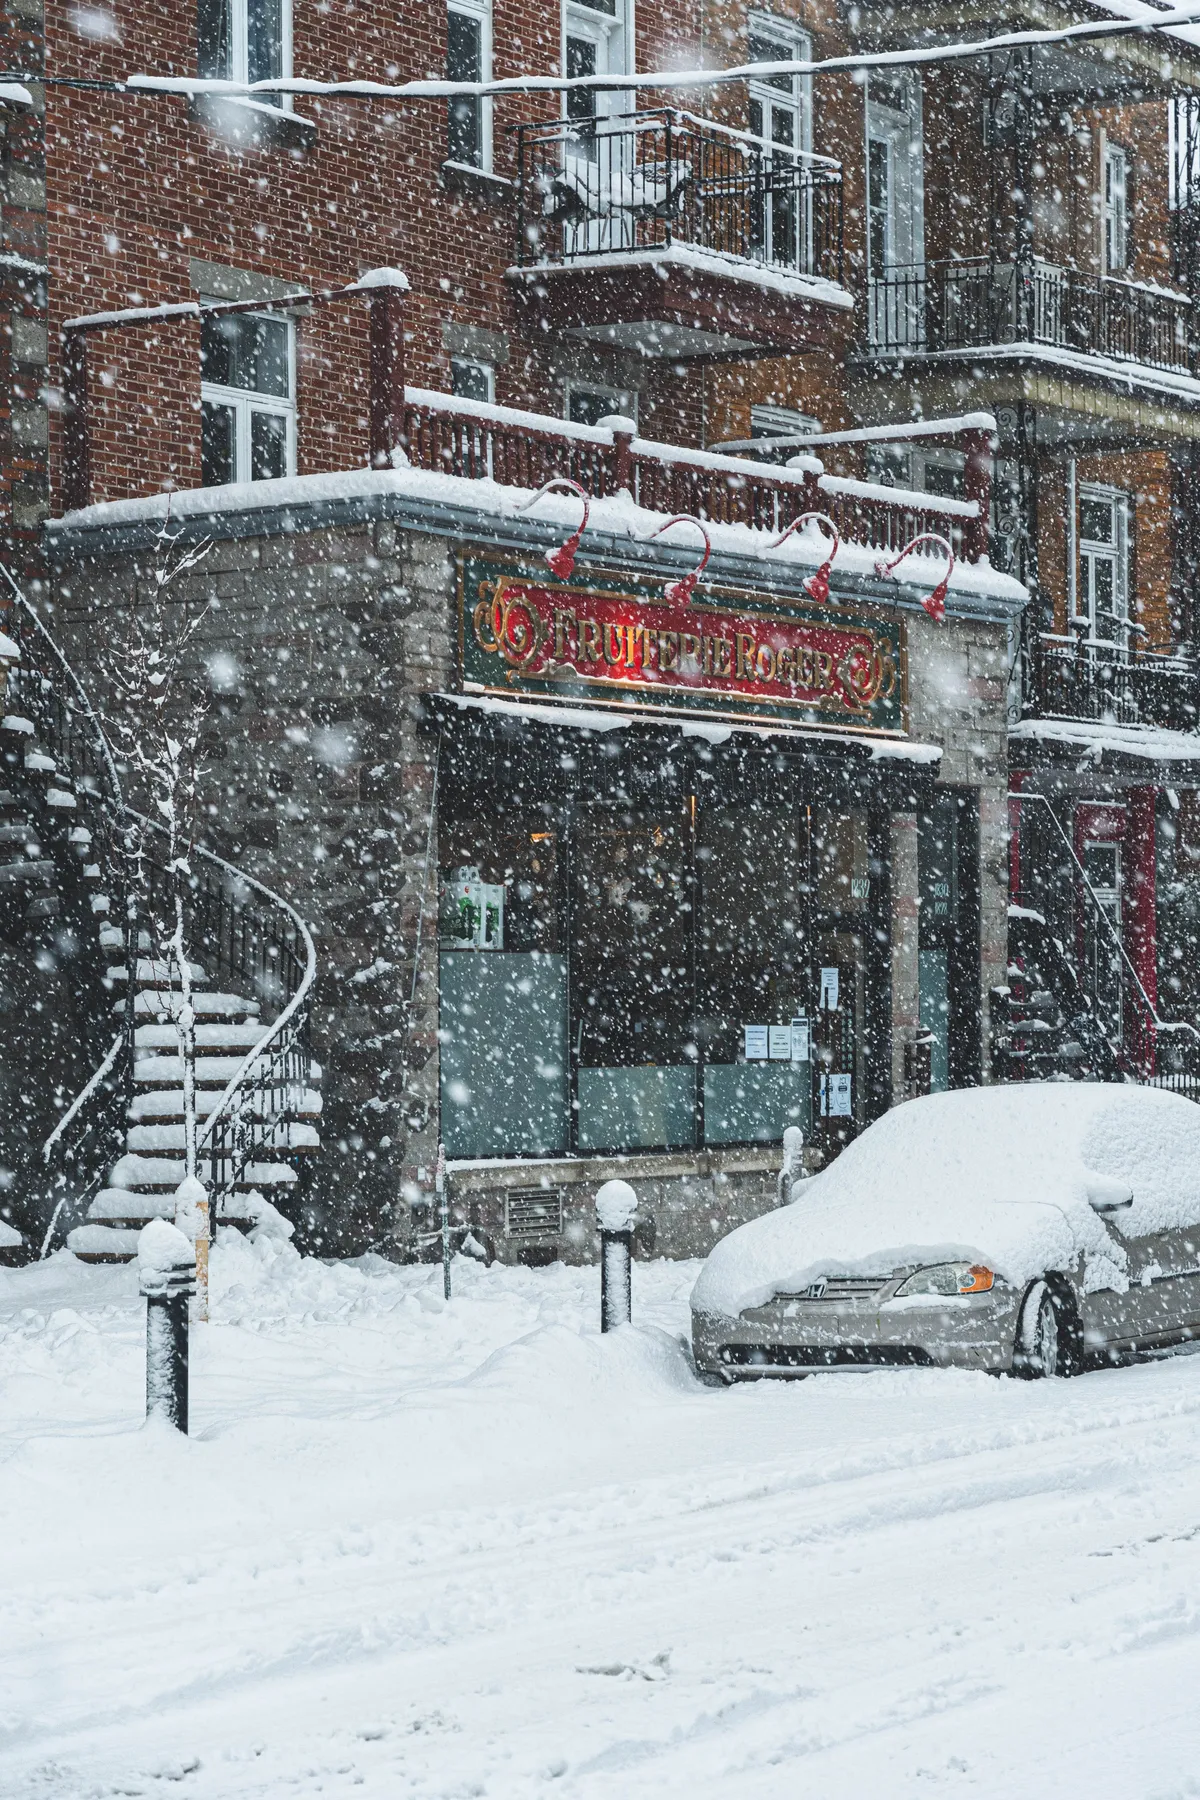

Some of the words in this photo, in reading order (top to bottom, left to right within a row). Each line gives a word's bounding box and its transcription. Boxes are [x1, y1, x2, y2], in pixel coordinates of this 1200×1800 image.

[553, 608, 732, 678] FRUITERIE
[735, 633, 834, 690] ROGER
[851, 878, 871, 899] 1832
